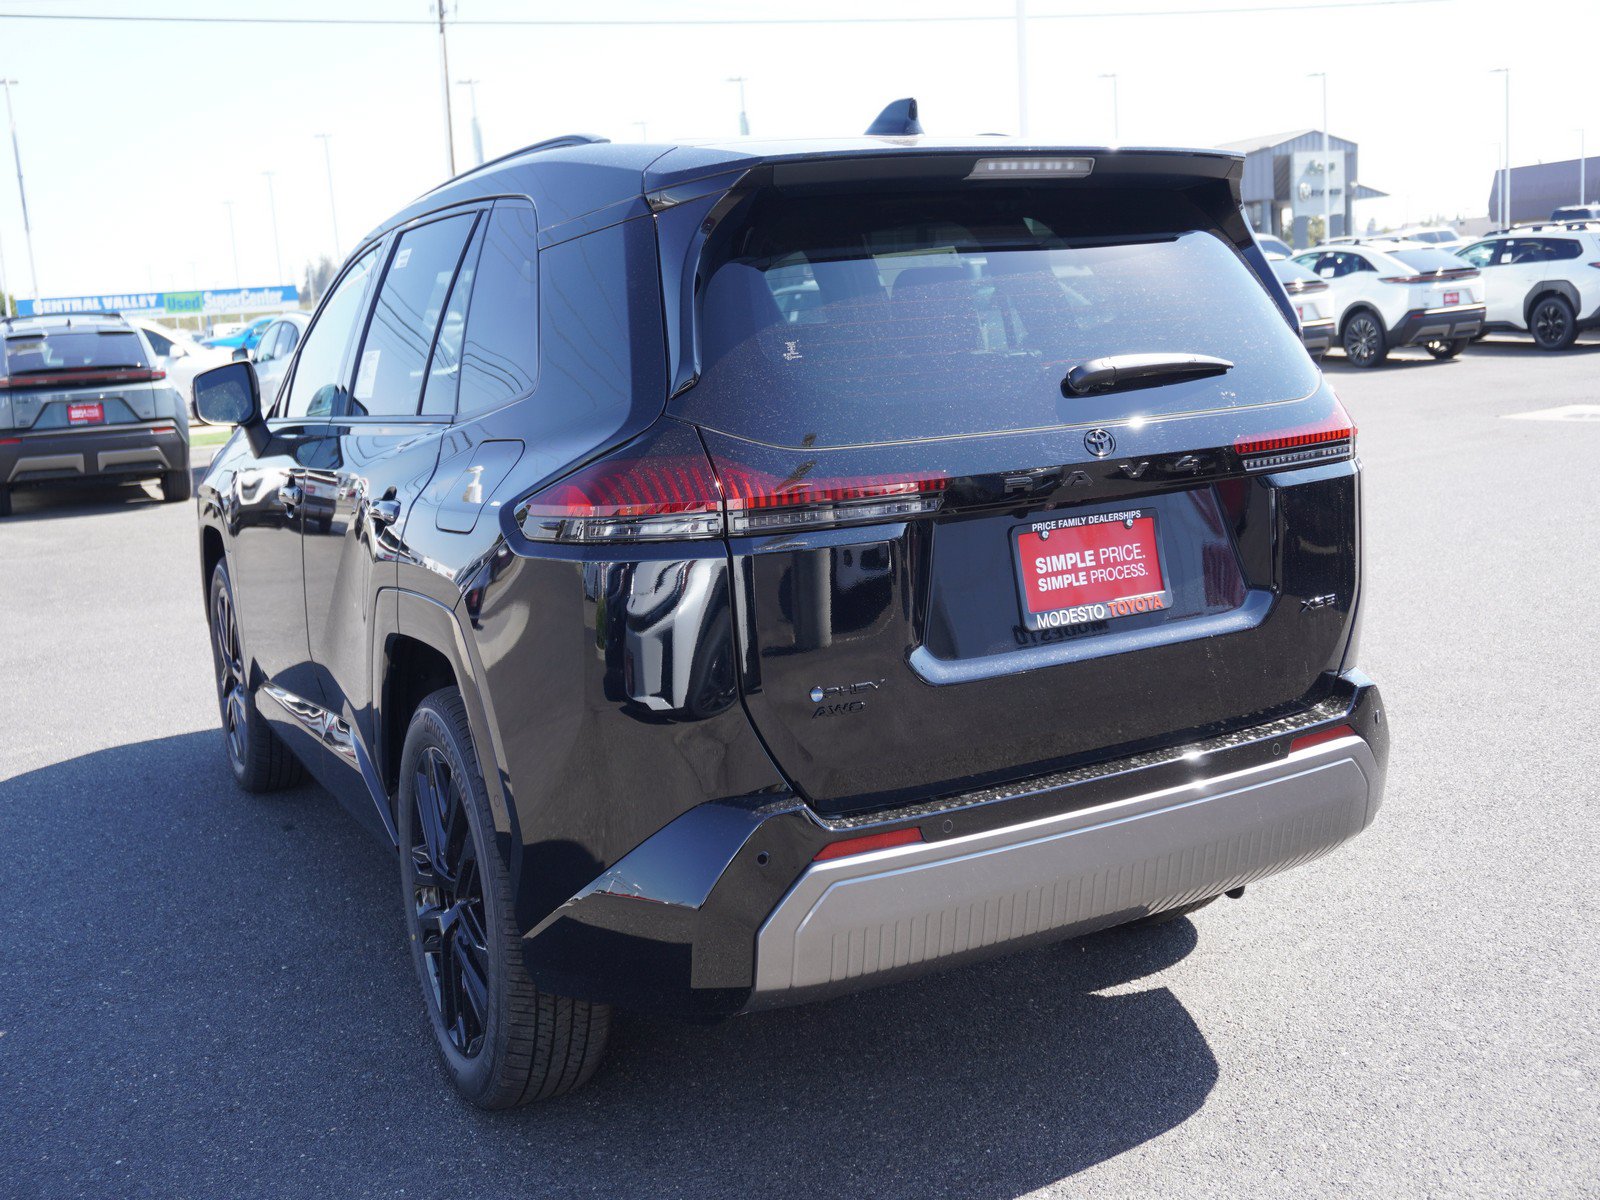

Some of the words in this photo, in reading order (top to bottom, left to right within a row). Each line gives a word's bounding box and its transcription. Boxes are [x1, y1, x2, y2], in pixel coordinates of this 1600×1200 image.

[33, 299, 101, 315] CENTRAL
[103, 294, 157, 309] VALLEY
[167, 295, 200, 311] Used
[1003, 454, 1203, 494] RAV4
[1032, 521, 1057, 532] PRICE
[1058, 516, 1087, 528] FAMILY
[1088, 510, 1142, 524] DEALERSHIPS
[1035, 550, 1096, 574] SIMPLE
[1099, 543, 1146, 565] PRICE.
[1037, 571, 1088, 592] SIMPLE
[1090, 562, 1149, 584] PROCESS.
[1036, 604, 1105, 629] MODESTO
[1107, 594, 1164, 617] TOYOTA
